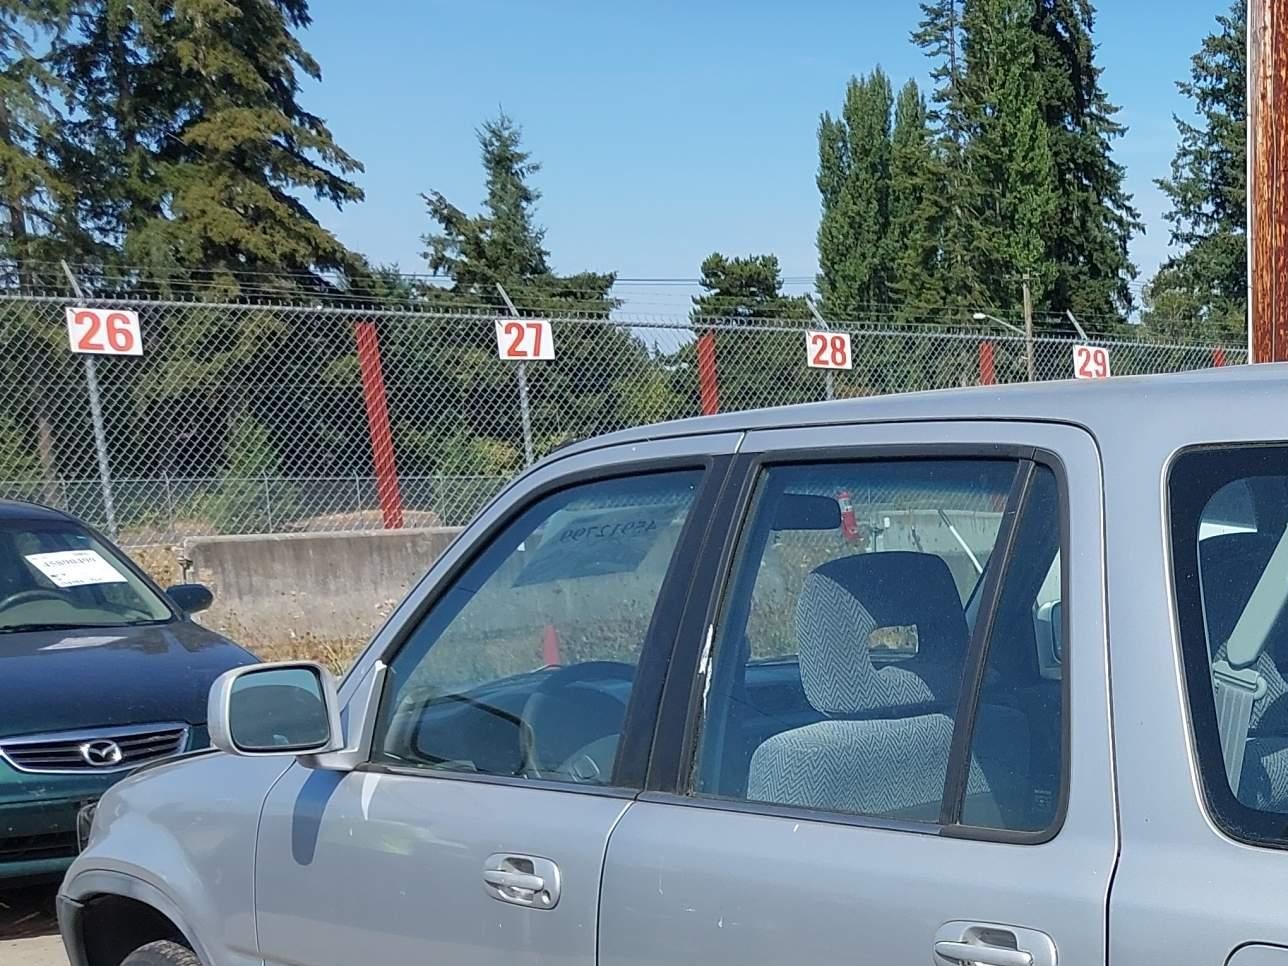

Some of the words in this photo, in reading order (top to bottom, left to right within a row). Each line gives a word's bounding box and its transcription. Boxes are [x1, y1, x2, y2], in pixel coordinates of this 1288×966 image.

[75, 311, 134, 352] 26
[505, 323, 542, 357] 27
[812, 335, 847, 366] 28
[1078, 348, 1107, 378] 29
